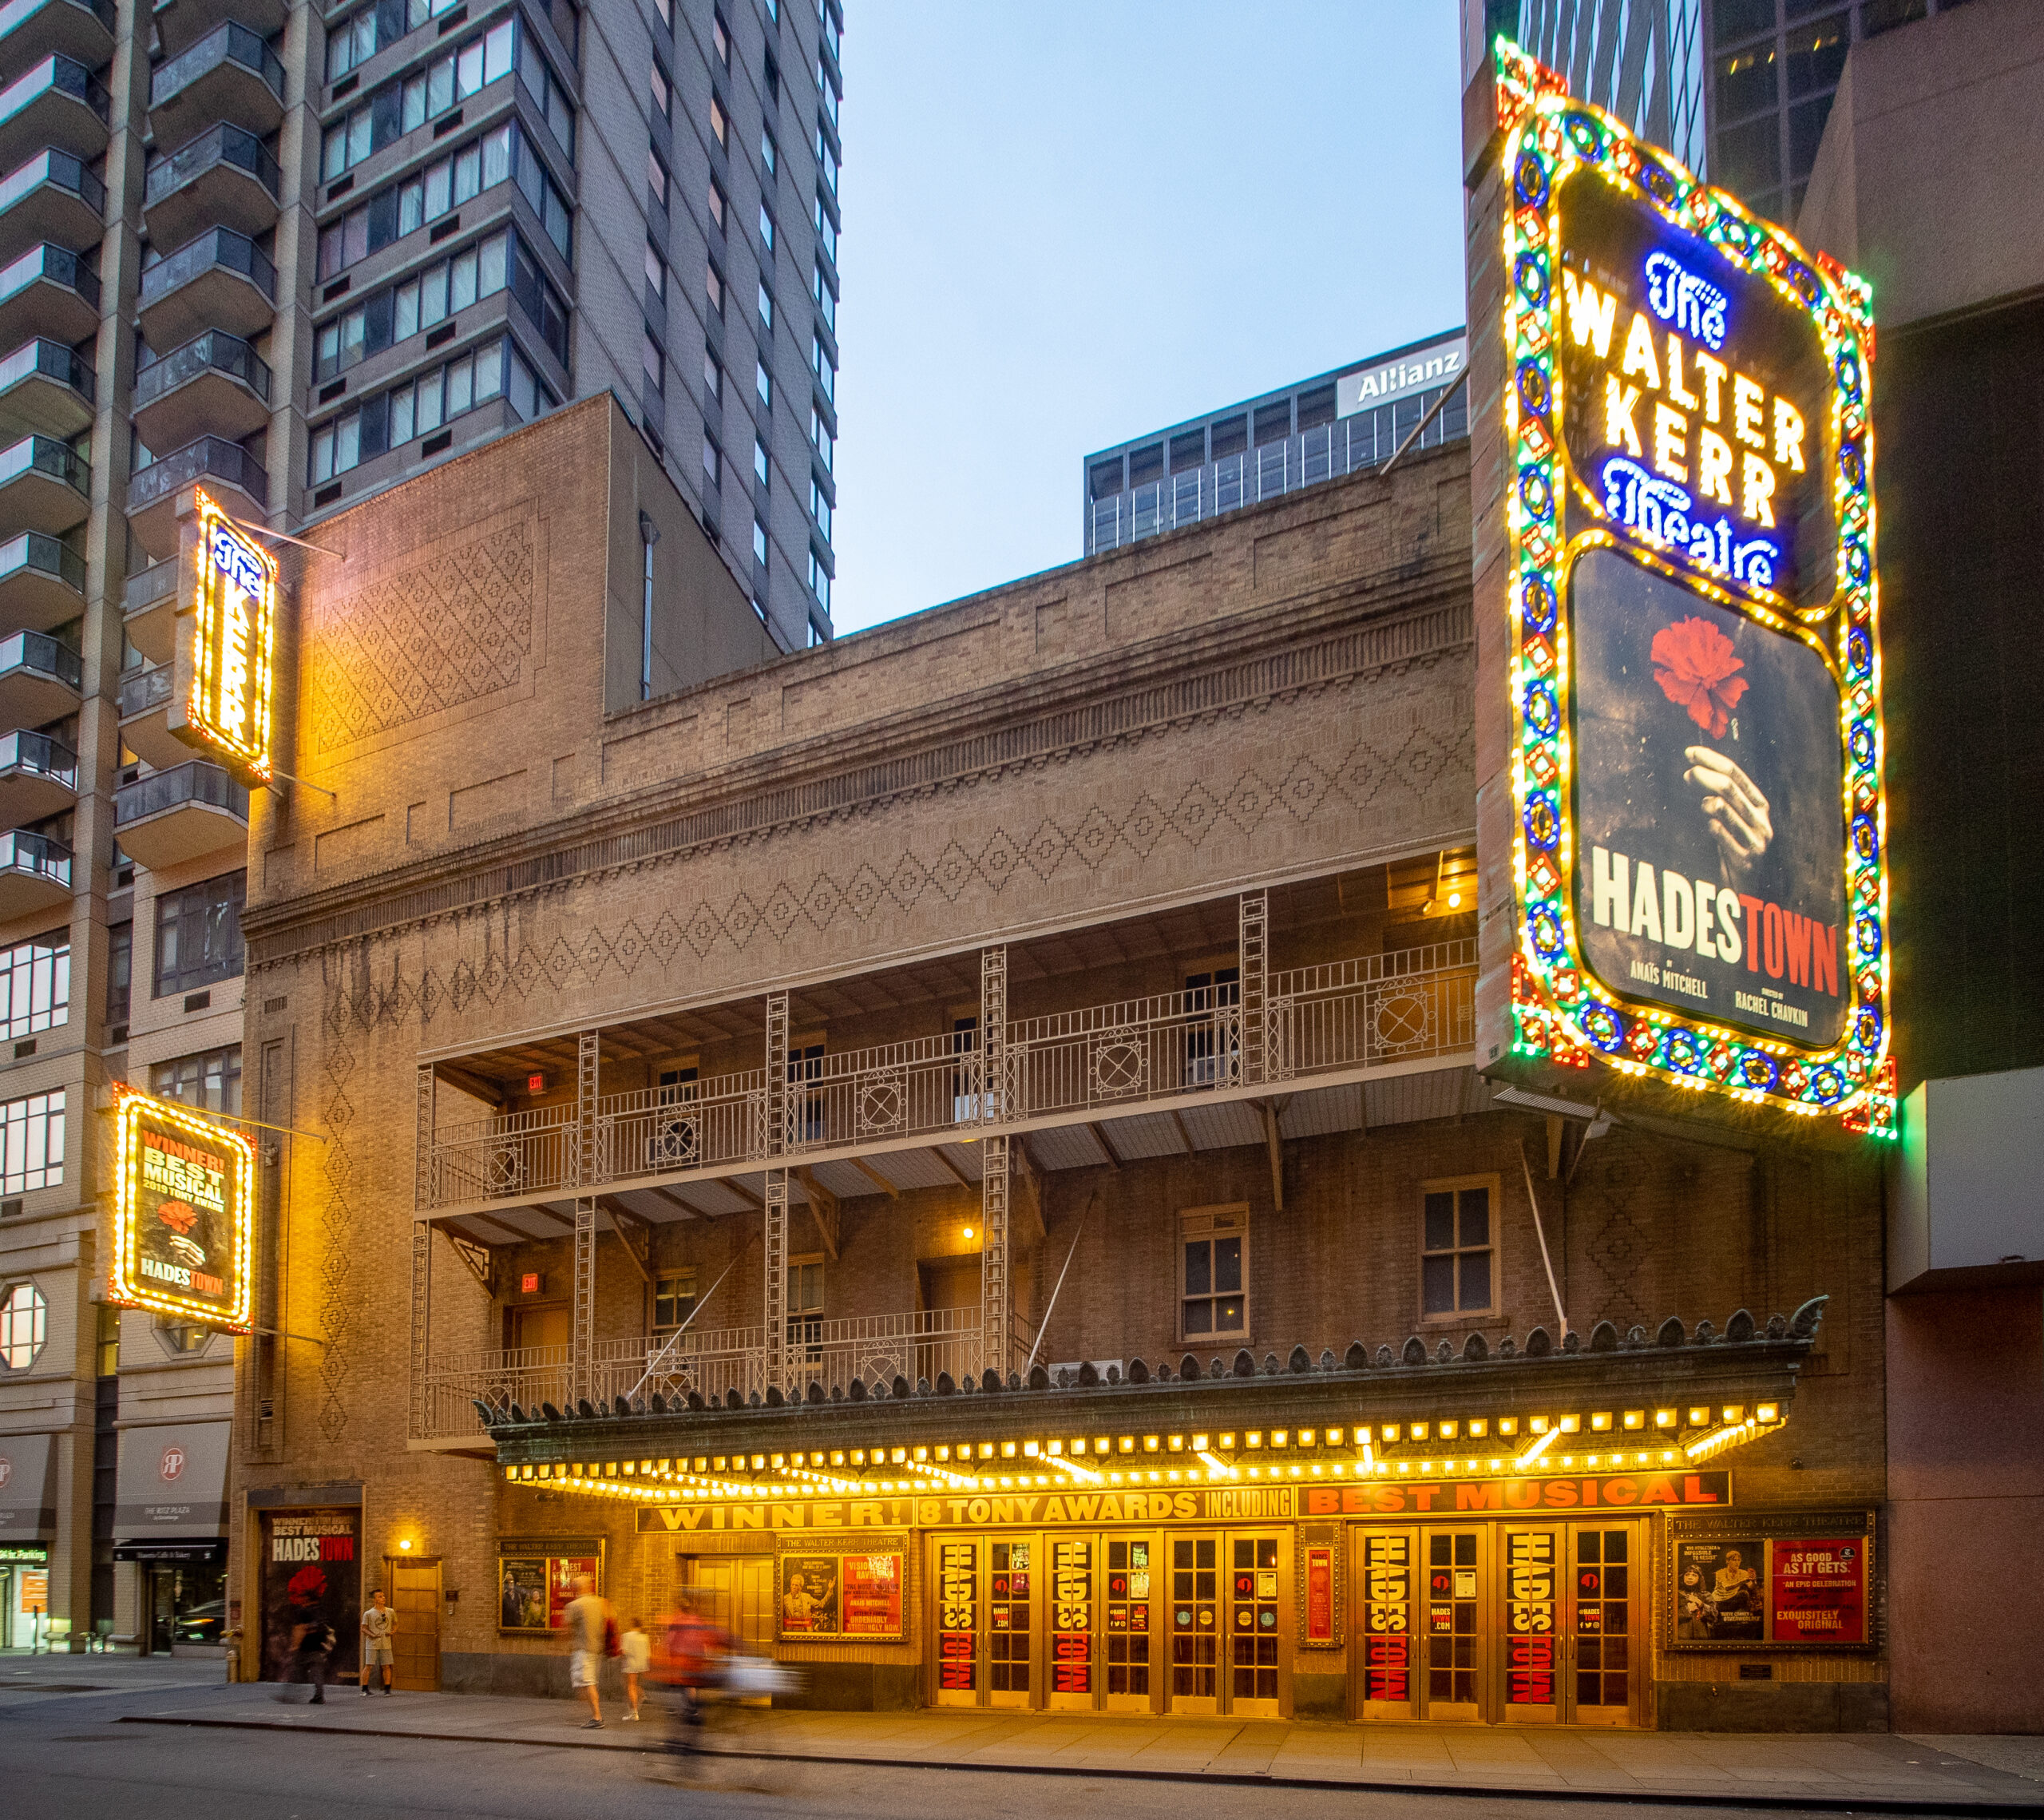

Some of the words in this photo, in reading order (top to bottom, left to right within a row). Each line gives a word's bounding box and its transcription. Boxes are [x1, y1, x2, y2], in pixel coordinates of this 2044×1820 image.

[1646, 252, 1727, 350] The
[1358, 351, 1460, 402] Allianz
[1563, 267, 1806, 473] WALTER
[1605, 371, 1776, 528] KERR
[1602, 458, 1778, 588] Theatre
[215, 531, 262, 598] The
[1593, 846, 1838, 997] HADESTOWN
[1630, 960, 1659, 985] ANAÏS
[1662, 969, 1708, 998] MITCHELL
[1735, 990, 1769, 1017] RACHEL
[1771, 1001, 1808, 1028] CHAVKIN
[143, 1129, 225, 1174] WINNER!
[144, 1146, 224, 1187] BEST
[143, 1179, 168, 1195] 2019
[169, 1186, 194, 1202] TONY
[194, 1195, 224, 1213] AWARD
[144, 1161, 224, 1204] MUSICAL
[141, 1257, 224, 1295] HADESTOWN
[919, 1501, 941, 1525] 8
[946, 1497, 1040, 1523] TONY
[1043, 1493, 1198, 1521] AWARDS
[1205, 1489, 1290, 1517] INCLUDING
[1309, 1486, 1440, 1514] BEST
[1456, 1476, 1717, 1510] MUSICAL
[273, 1526, 302, 1536] BEST
[303, 1525, 353, 1535] MUSICAL
[658, 1501, 901, 1530] WINNER!
[1676, 1521, 1701, 1530] THE
[1706, 1519, 1756, 1529] WALTER
[1762, 1517, 1797, 1527] KERR
[1803, 1516, 1864, 1526] THEATRE
[272, 1537, 353, 1561] HADESTOWN
[804, 1538, 834, 1547] WALTER
[1790, 1553, 1803, 1562] AS
[1806, 1553, 1832, 1562] GOOD
[1783, 1563, 1799, 1574] AS
[1802, 1563, 1814, 1574] IT
[1777, 1610, 1839, 1620] EXQUISITELY
[1797, 1620, 1844, 1629] ORIGINAL
